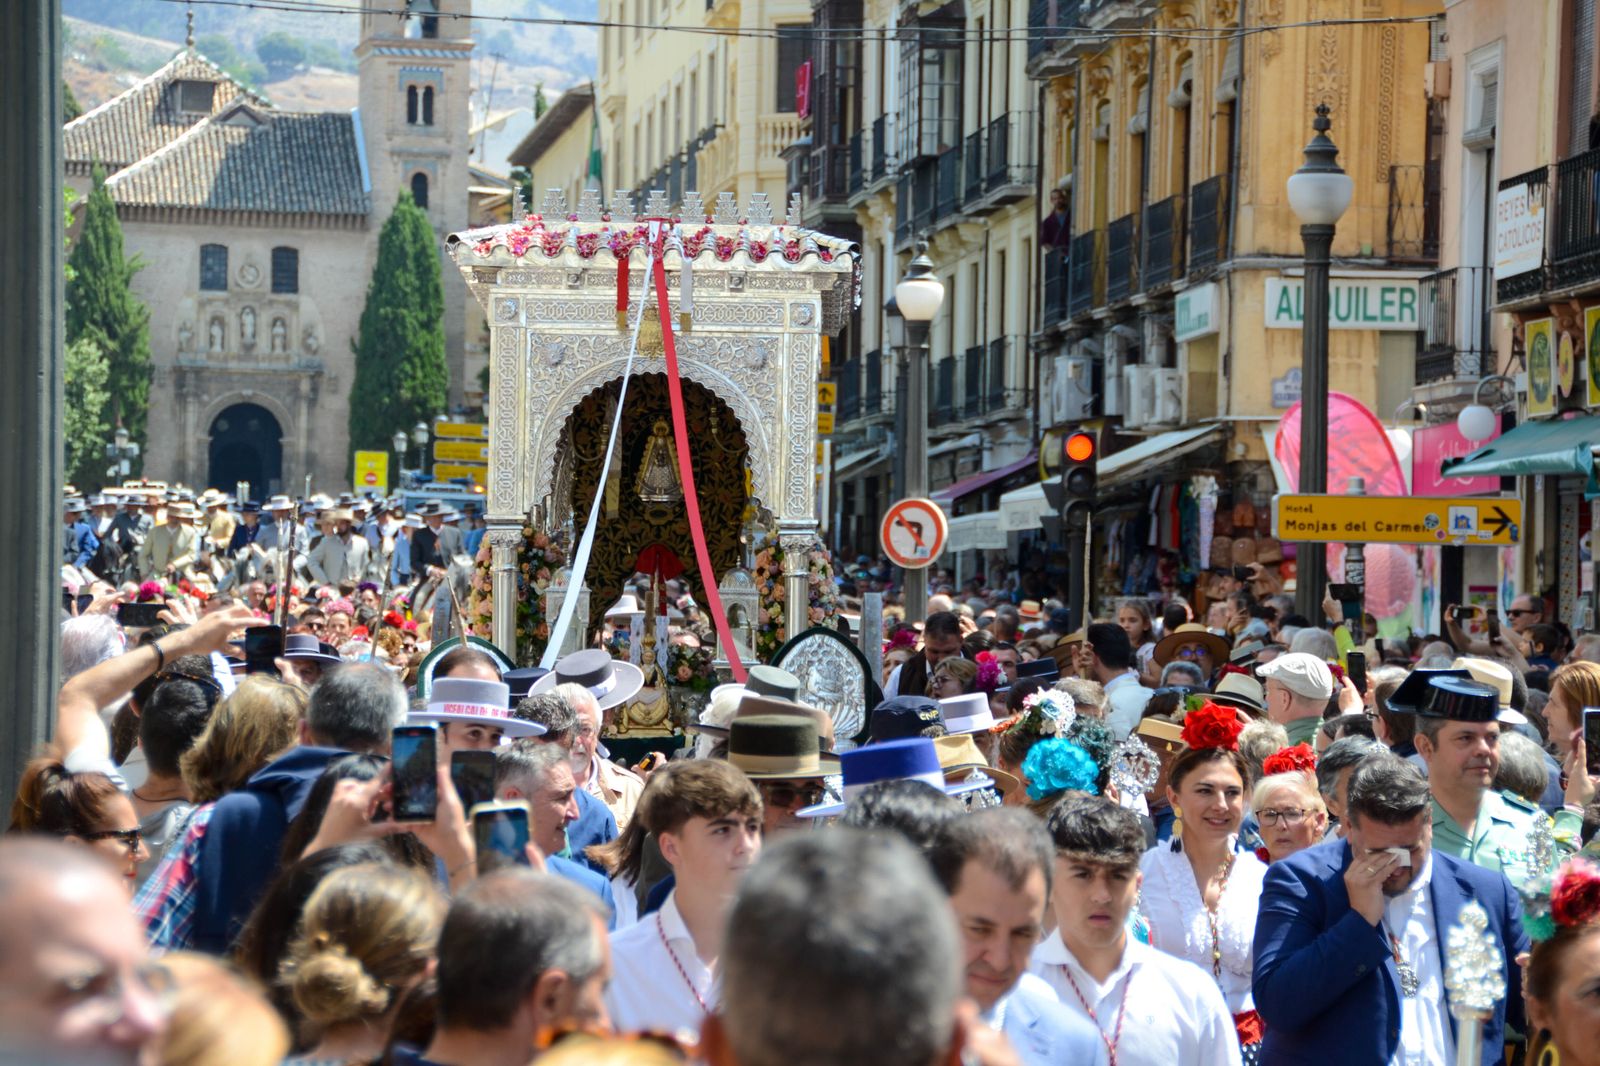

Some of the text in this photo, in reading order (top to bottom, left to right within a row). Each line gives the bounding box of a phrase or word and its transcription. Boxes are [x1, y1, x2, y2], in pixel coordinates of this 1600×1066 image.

[1499, 195, 1525, 221] REYES
[1275, 285, 1417, 323] ALUILER
[1285, 503, 1314, 514] Hotel
[1285, 519, 1338, 534] Monjas
[1344, 520, 1367, 533] del
[919, 710, 939, 720] CNP
